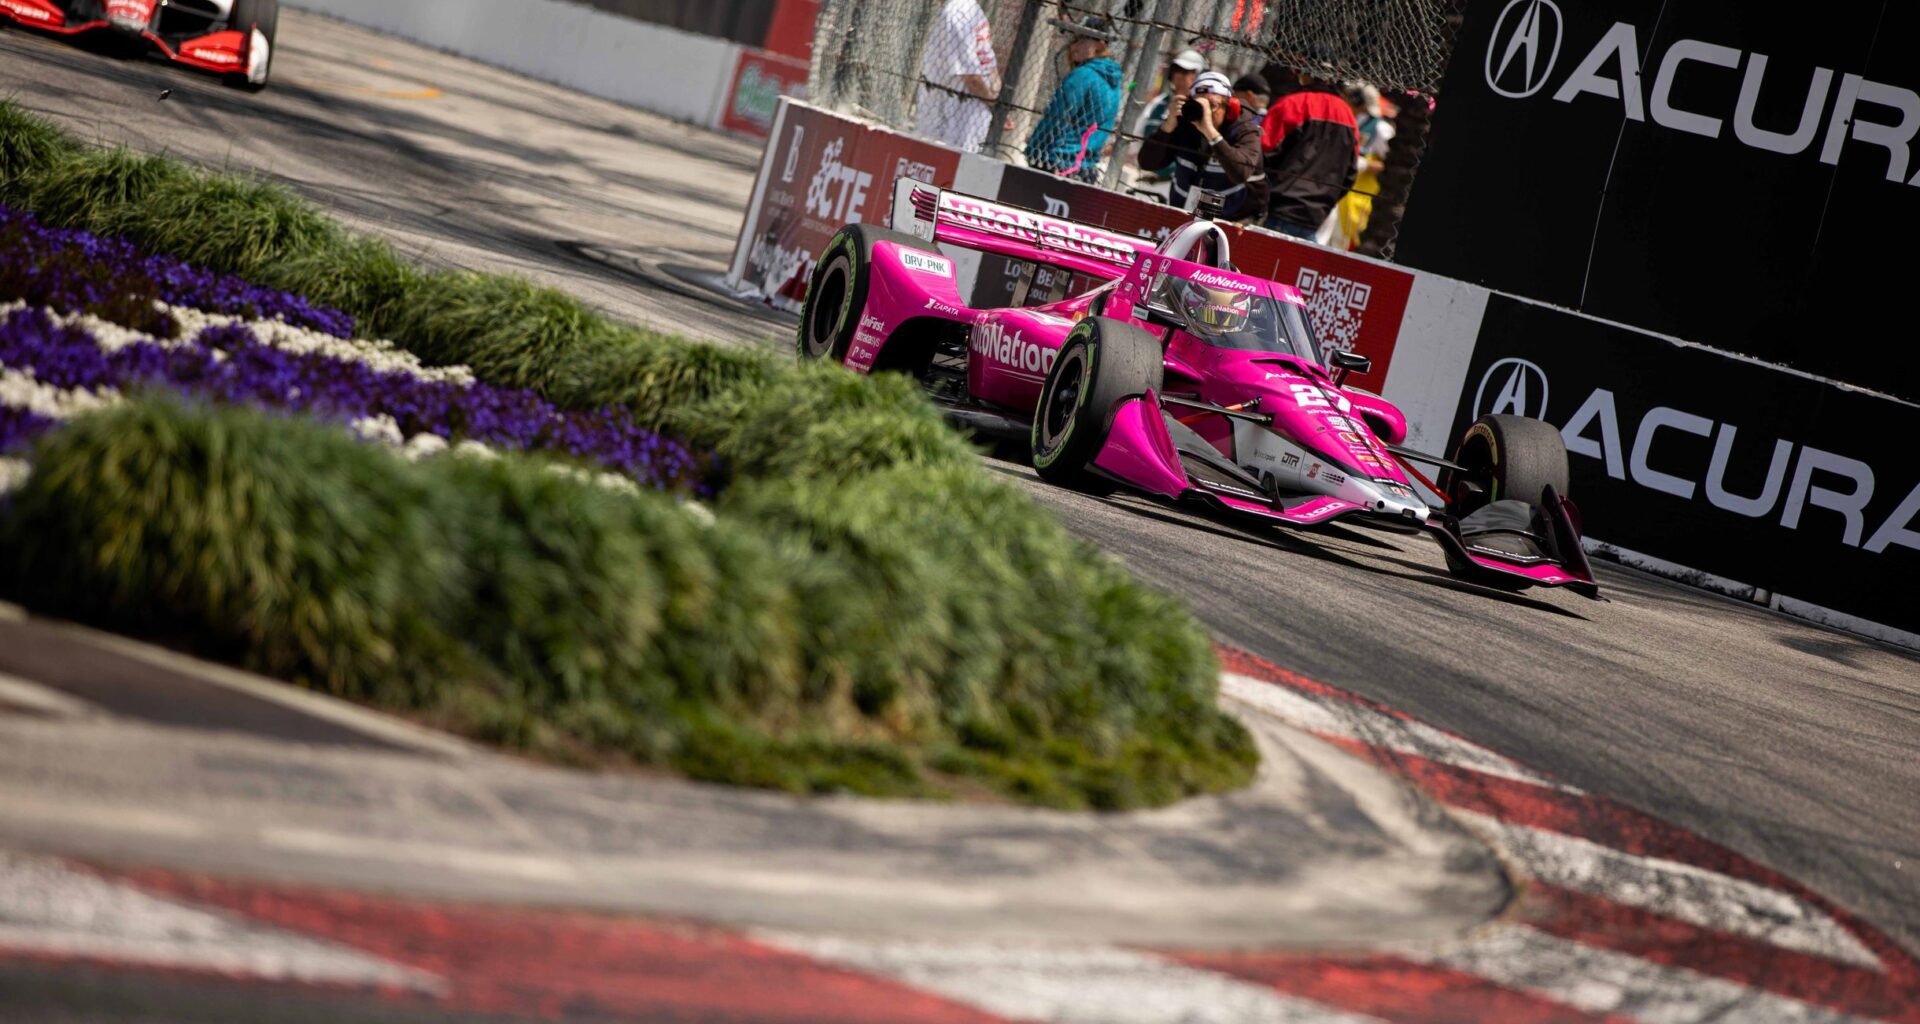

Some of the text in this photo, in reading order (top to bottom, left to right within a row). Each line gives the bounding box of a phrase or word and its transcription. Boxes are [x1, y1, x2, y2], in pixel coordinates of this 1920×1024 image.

[1552, 21, 1920, 188] ACUR
[938, 197, 1135, 264] AutoNation
[904, 254, 946, 273] DRV PNK
[1190, 270, 1258, 293] AutoNation
[935, 303, 959, 316] ZAPATA
[1200, 303, 1239, 315] AutoNation
[861, 314, 885, 331] UniFirst
[970, 325, 1060, 374] AutoNation
[1290, 384, 1351, 413] 27
